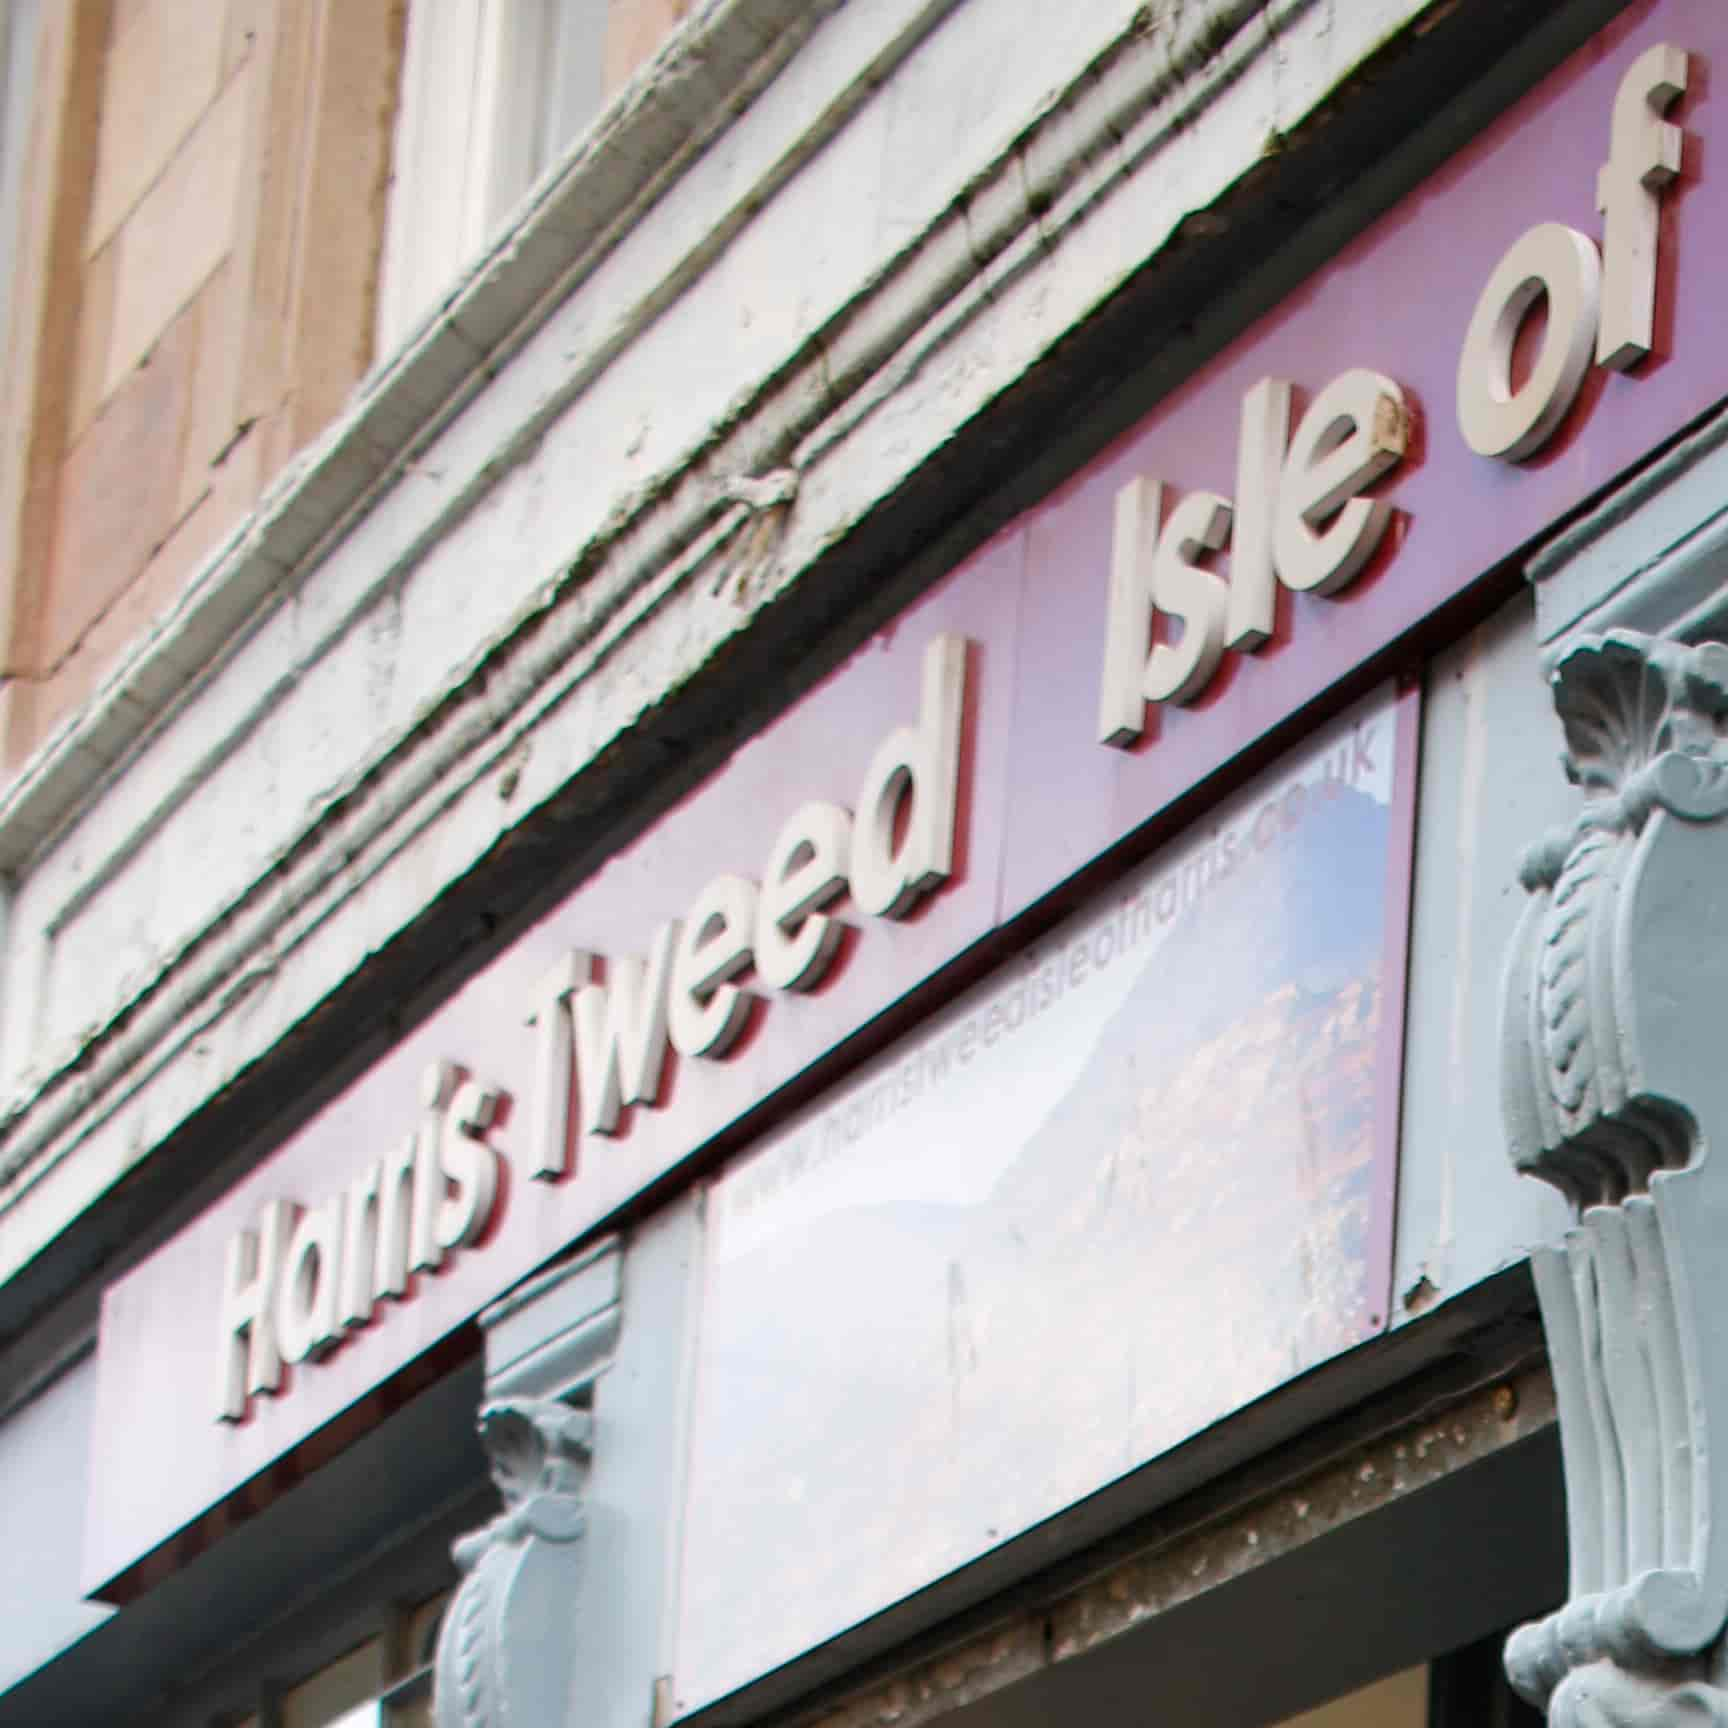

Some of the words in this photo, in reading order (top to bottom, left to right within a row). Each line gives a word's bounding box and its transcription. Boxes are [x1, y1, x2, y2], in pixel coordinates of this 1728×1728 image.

[217, 1057, 500, 1424] Harris
[527, 632, 966, 1181] Tweed
[1099, 368, 1412, 748] Isle
[1456, 42, 1688, 463] of
